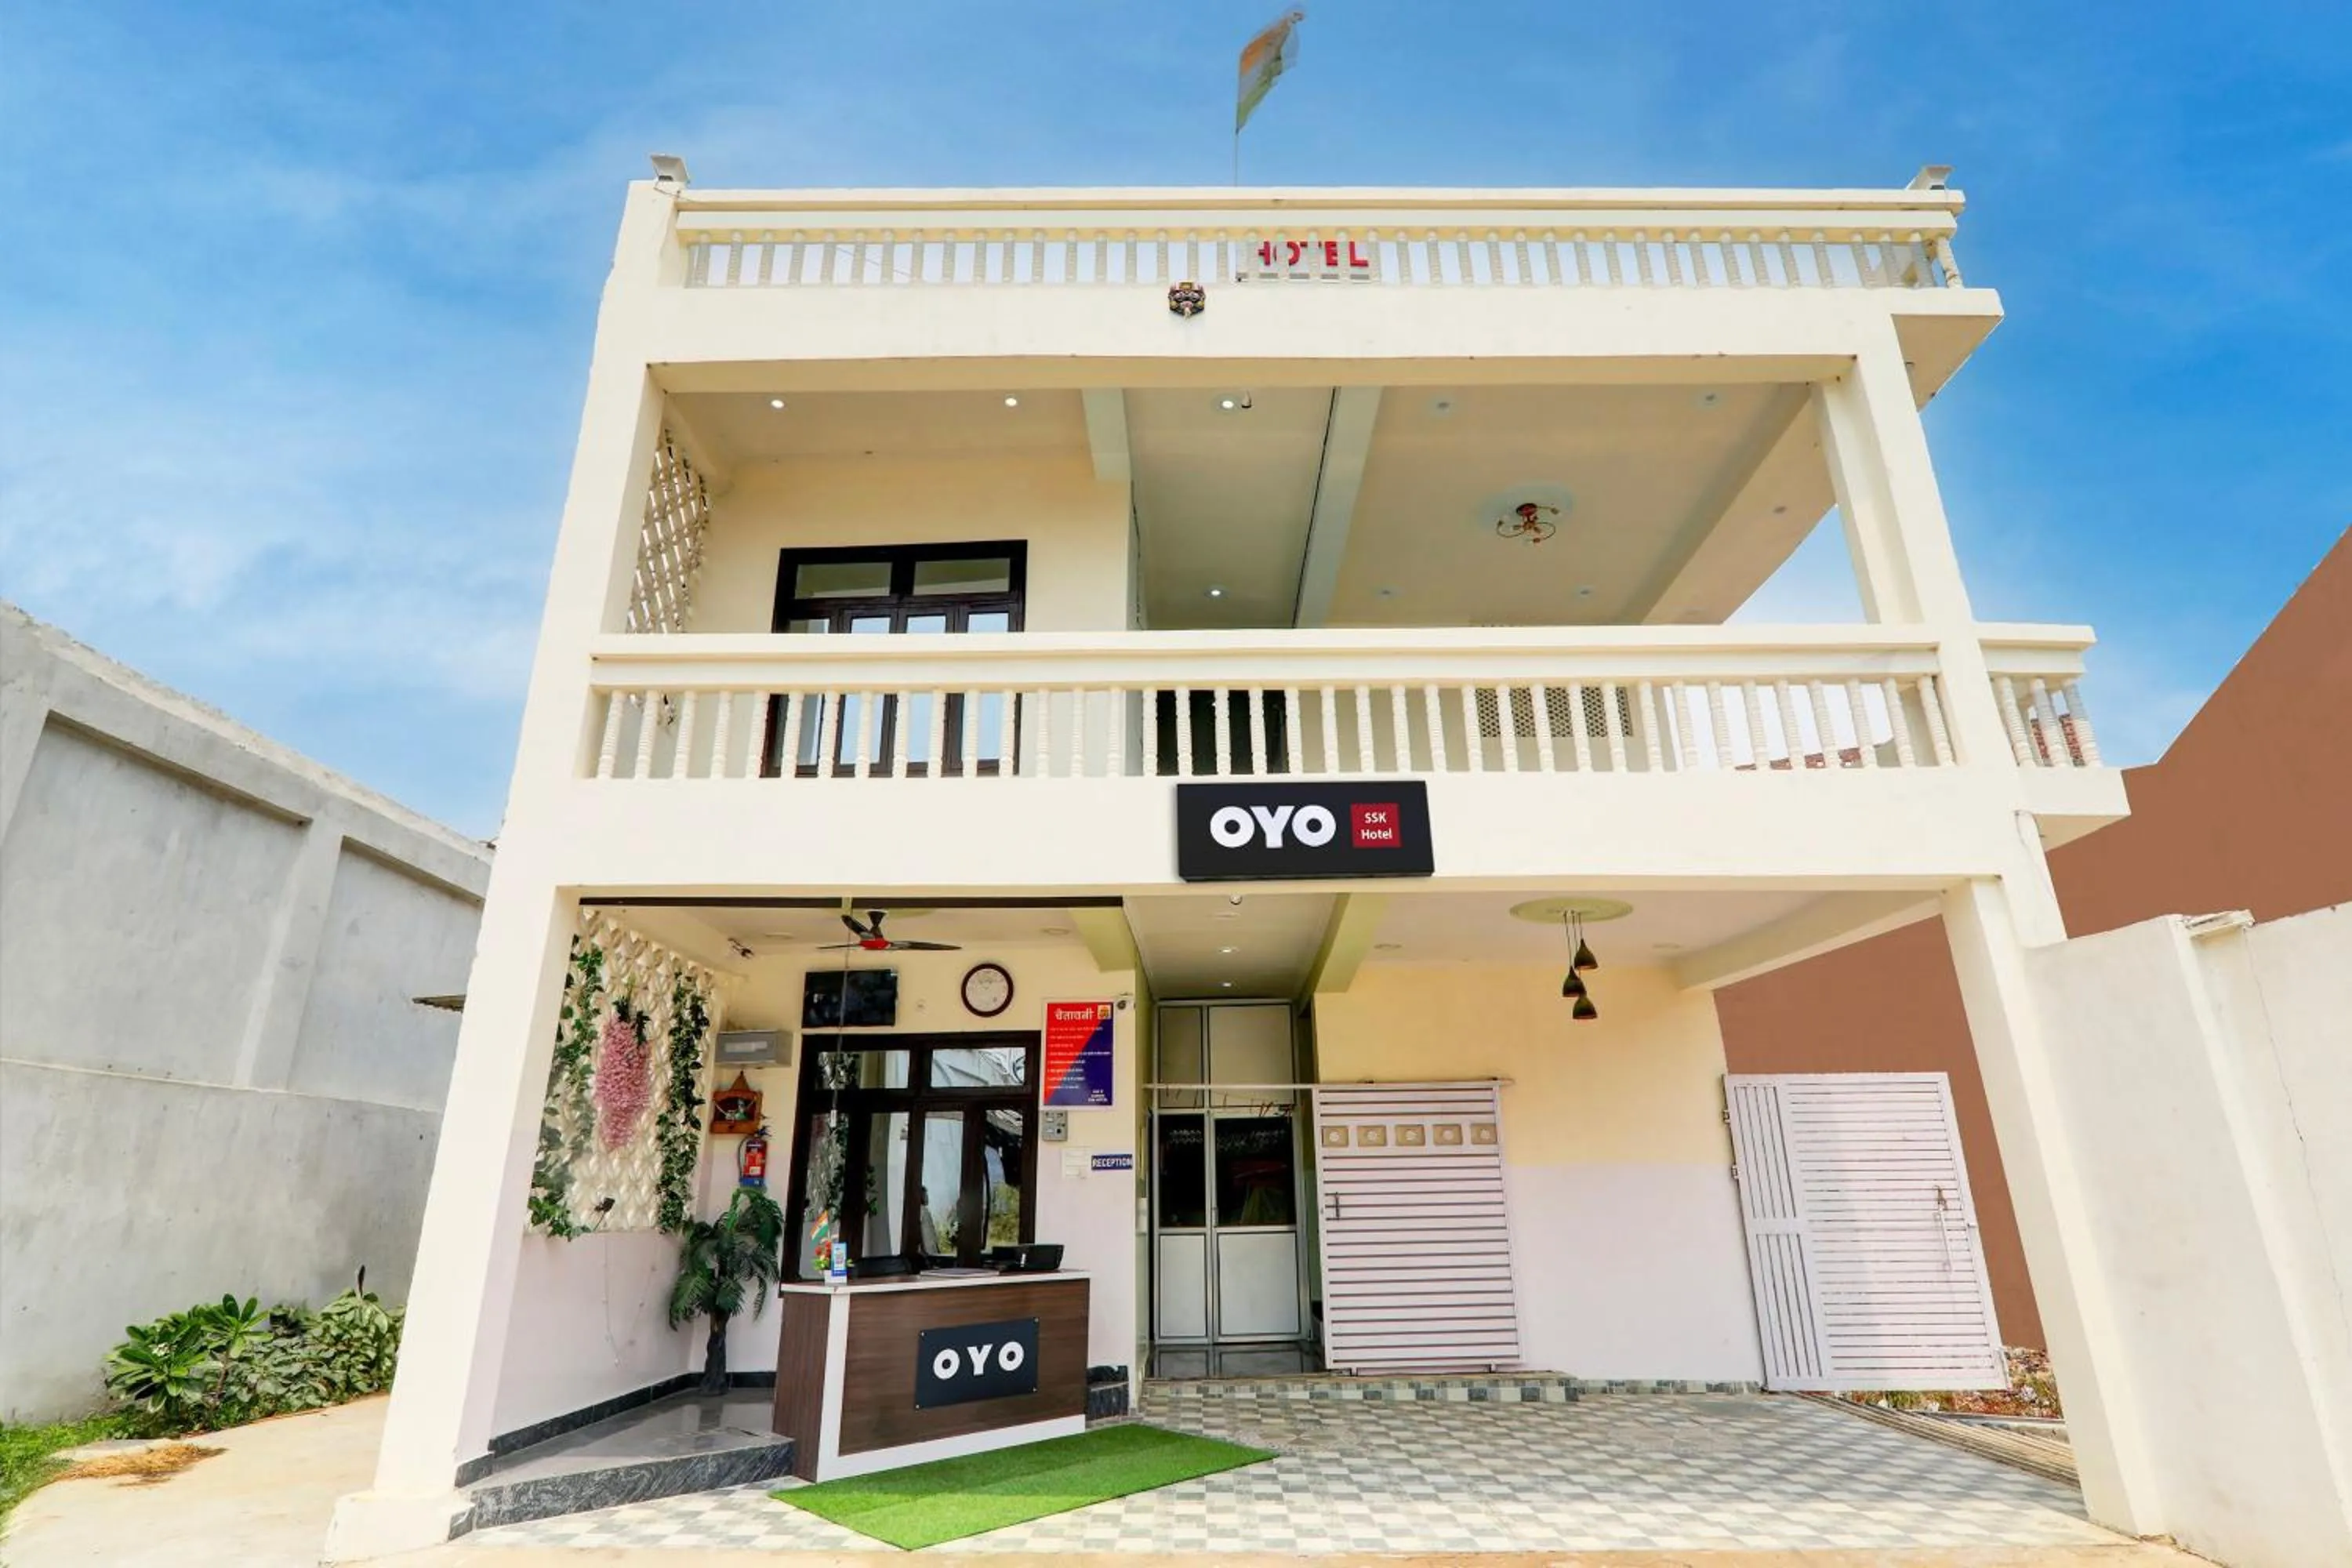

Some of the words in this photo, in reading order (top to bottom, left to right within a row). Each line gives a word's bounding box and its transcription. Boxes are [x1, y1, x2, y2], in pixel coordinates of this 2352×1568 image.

[1364, 812, 1387, 823] SSK
[1210, 804, 1336, 848] OYO
[1361, 827, 1392, 840] Hotel
[1092, 1157, 1133, 1167] RECEPTION
[933, 1341, 1025, 1380] OYO
